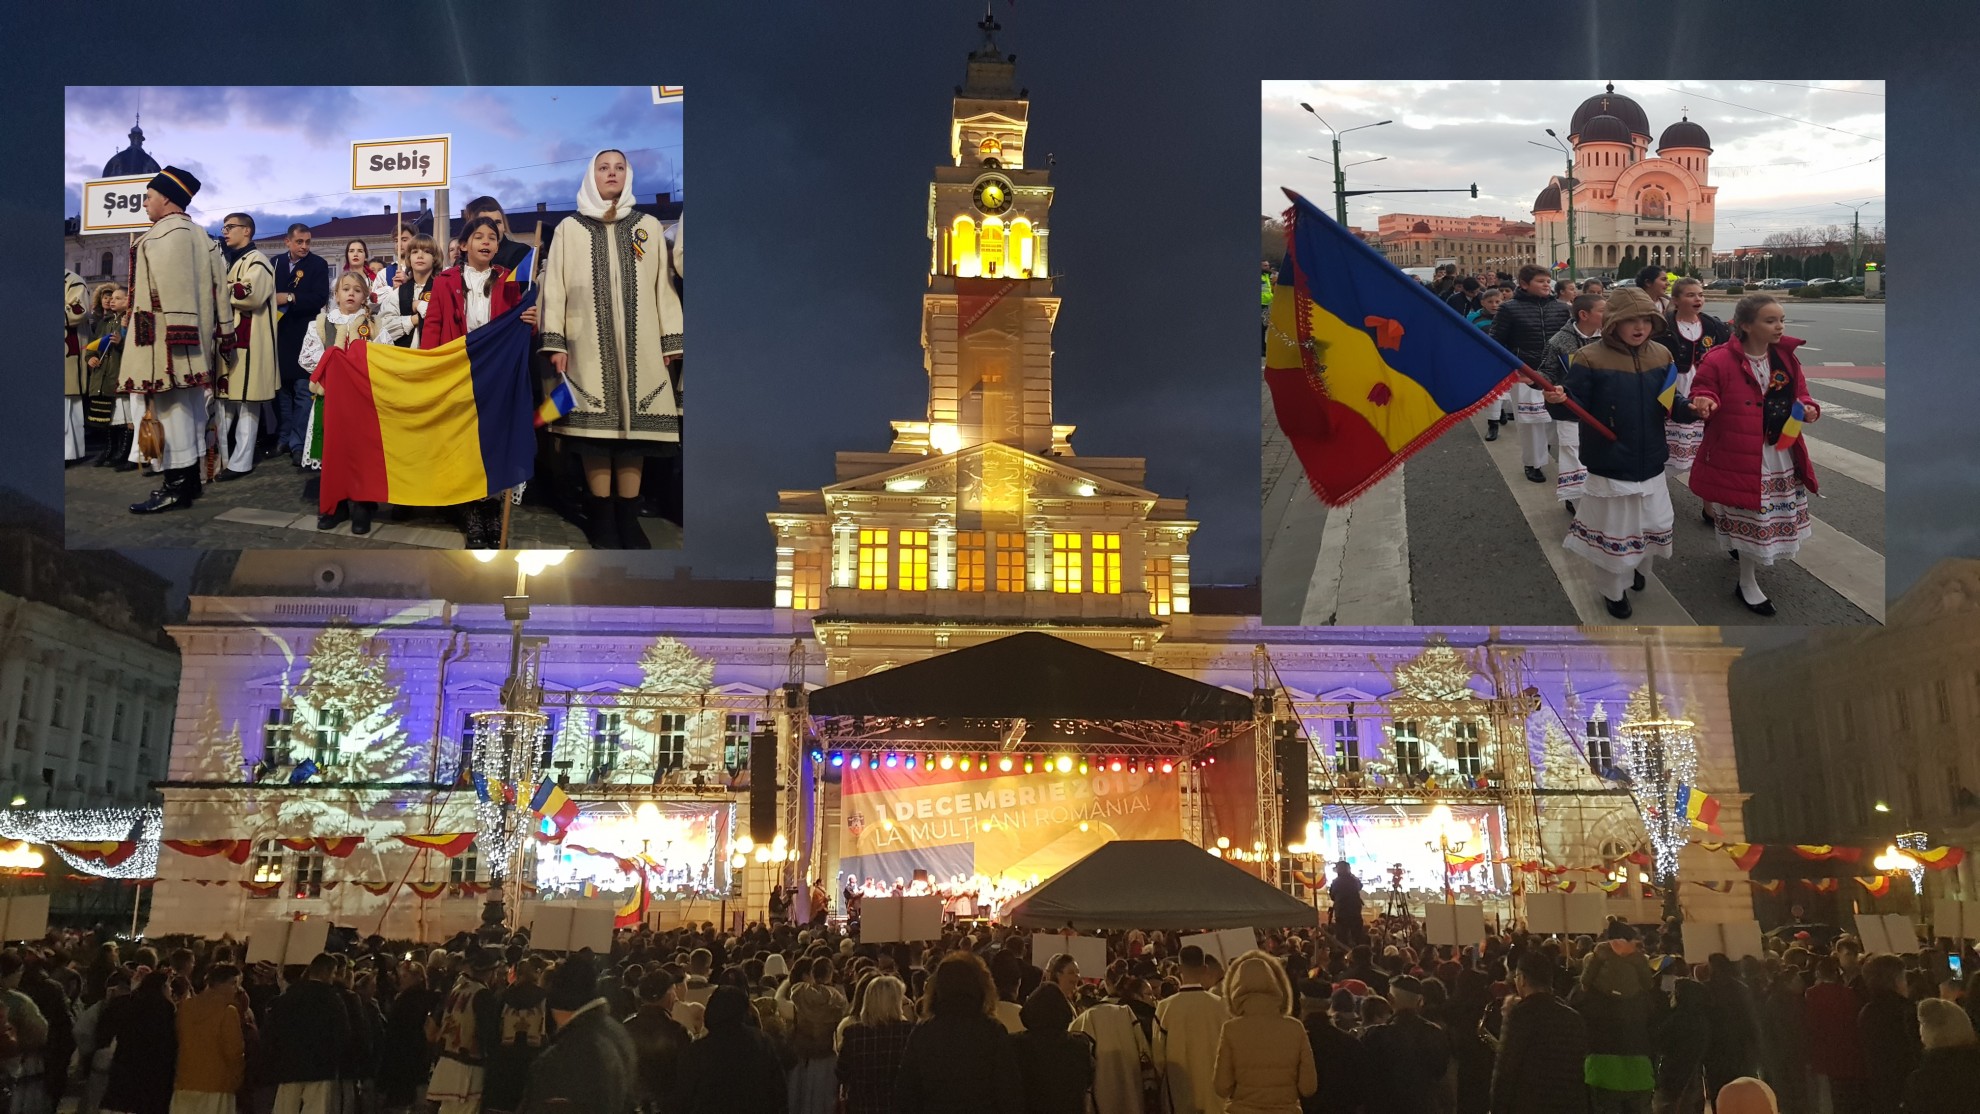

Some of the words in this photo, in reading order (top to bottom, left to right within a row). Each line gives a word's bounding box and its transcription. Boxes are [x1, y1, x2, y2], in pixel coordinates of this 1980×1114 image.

[369, 149, 431, 177] Sebiș
[1004, 405, 1020, 437] ANI
[876, 803, 888, 823] 1
[895, 782, 1066, 822] DECEMBRIE
[1071, 773, 1145, 799] 2019
[875, 826, 904, 847] LA
[986, 810, 1027, 830] ANI
[1035, 794, 1152, 828] ROMÂNIA!
